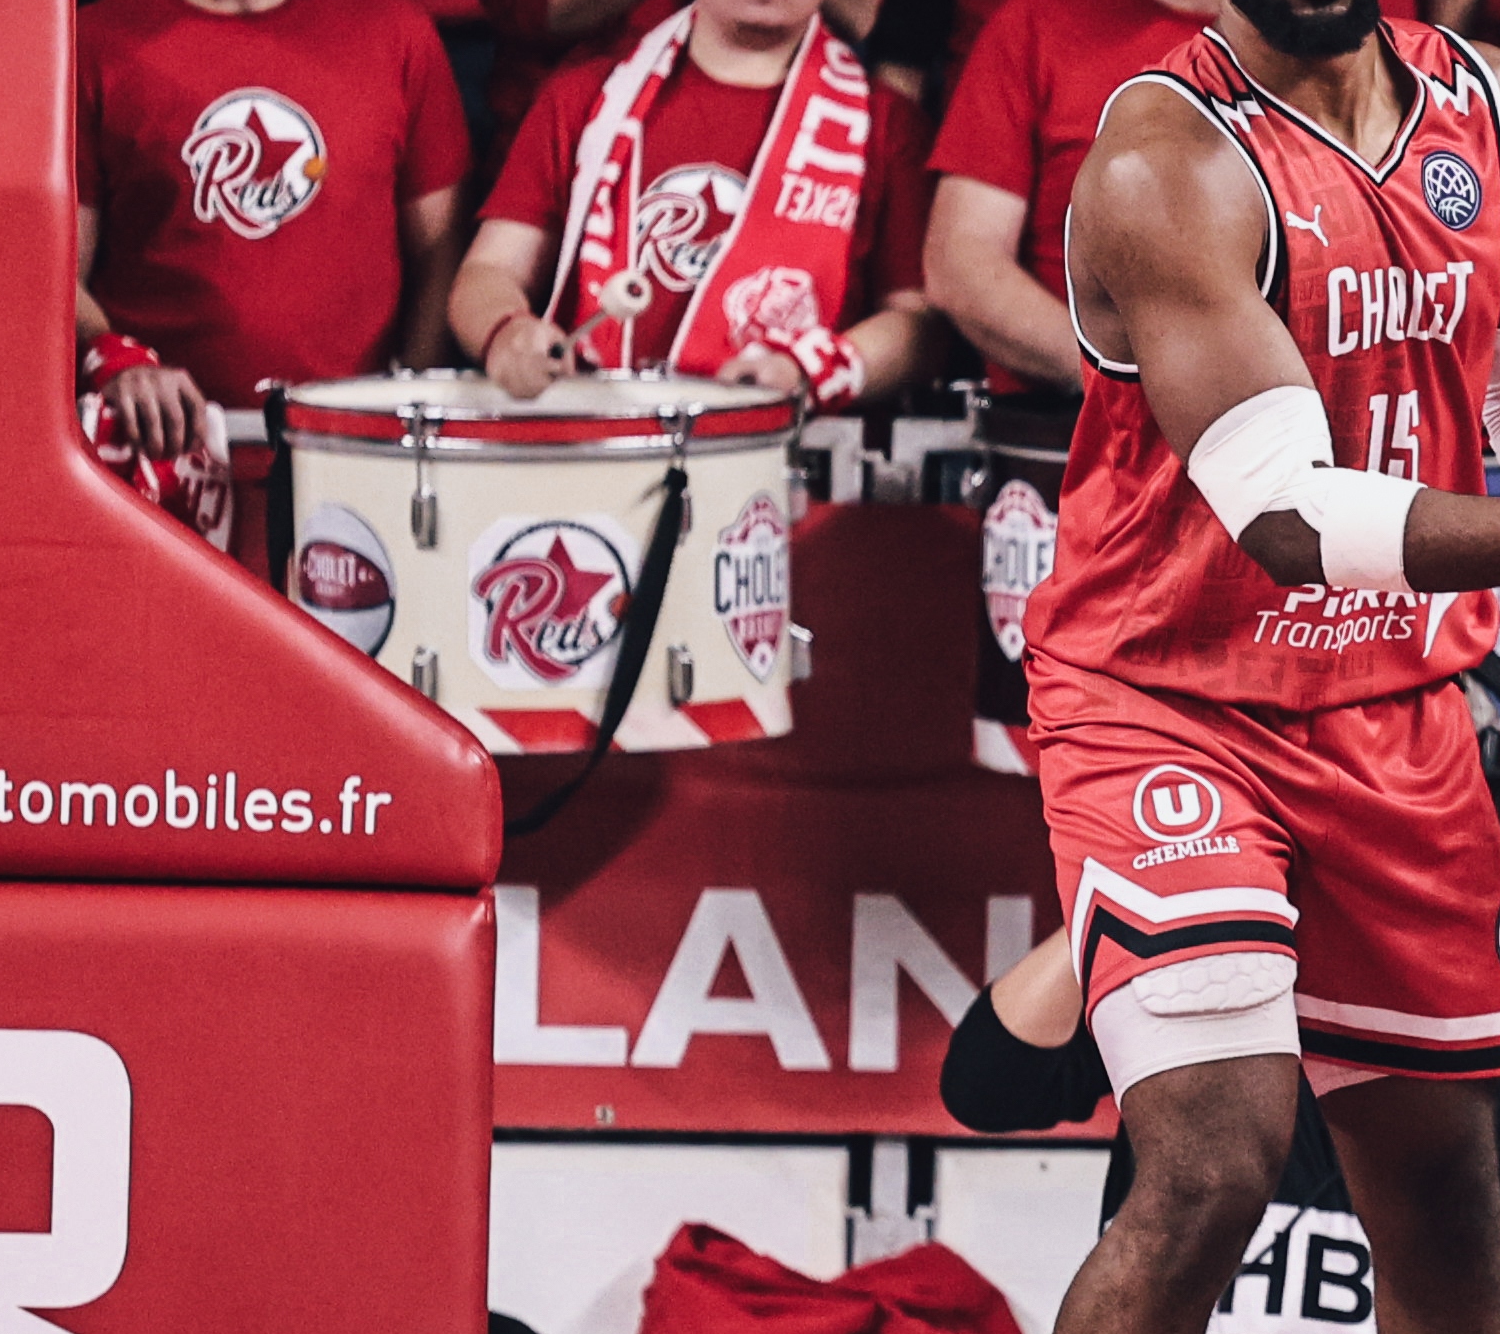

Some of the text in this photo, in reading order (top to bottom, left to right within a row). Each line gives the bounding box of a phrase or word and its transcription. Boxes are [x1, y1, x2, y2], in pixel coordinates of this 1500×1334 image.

[1327, 261, 1475, 357] CHOLET
[1366, 389, 1421, 483] 15
[1254, 608, 1415, 656] Transports
[1132, 834, 1241, 870] CHEMILLÉ
